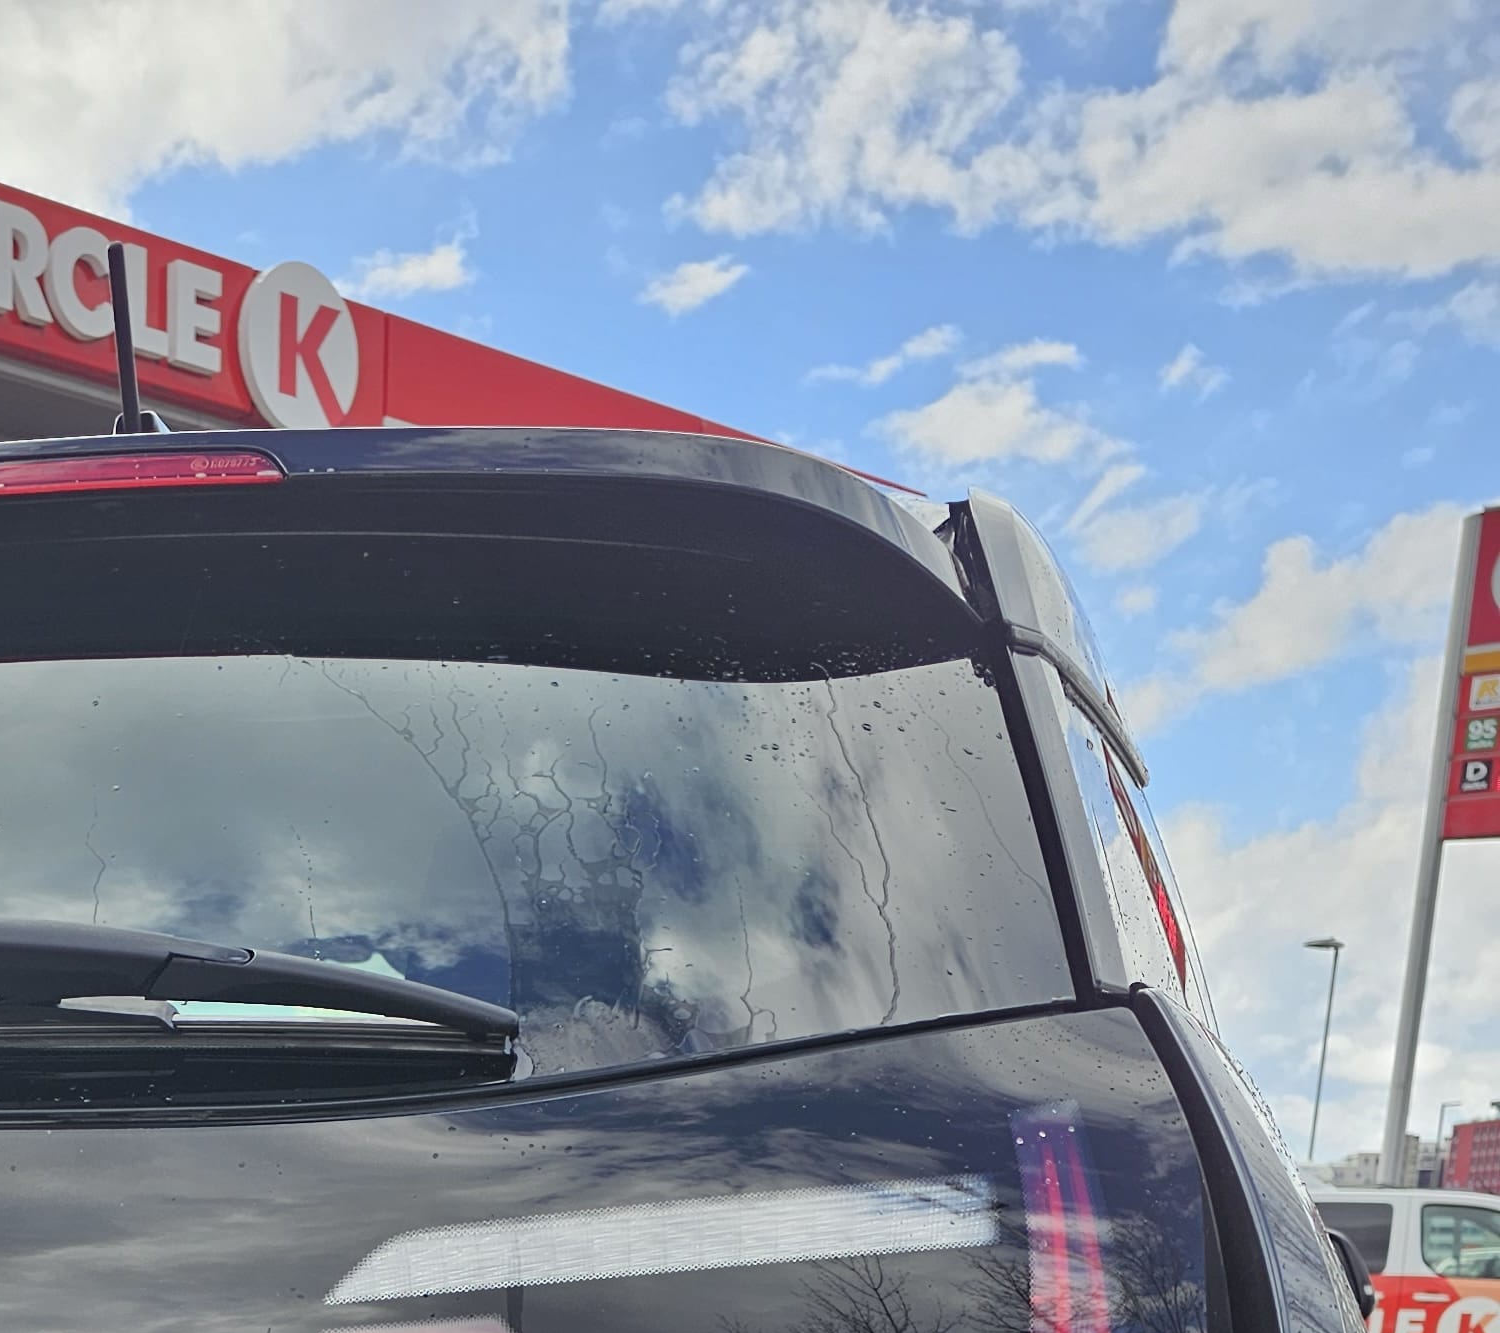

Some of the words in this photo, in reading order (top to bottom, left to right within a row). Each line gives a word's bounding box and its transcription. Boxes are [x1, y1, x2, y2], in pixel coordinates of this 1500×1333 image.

[277, 291, 349, 428] K
[1468, 718, 1498, 741] 95
[1465, 761, 1488, 782] D
